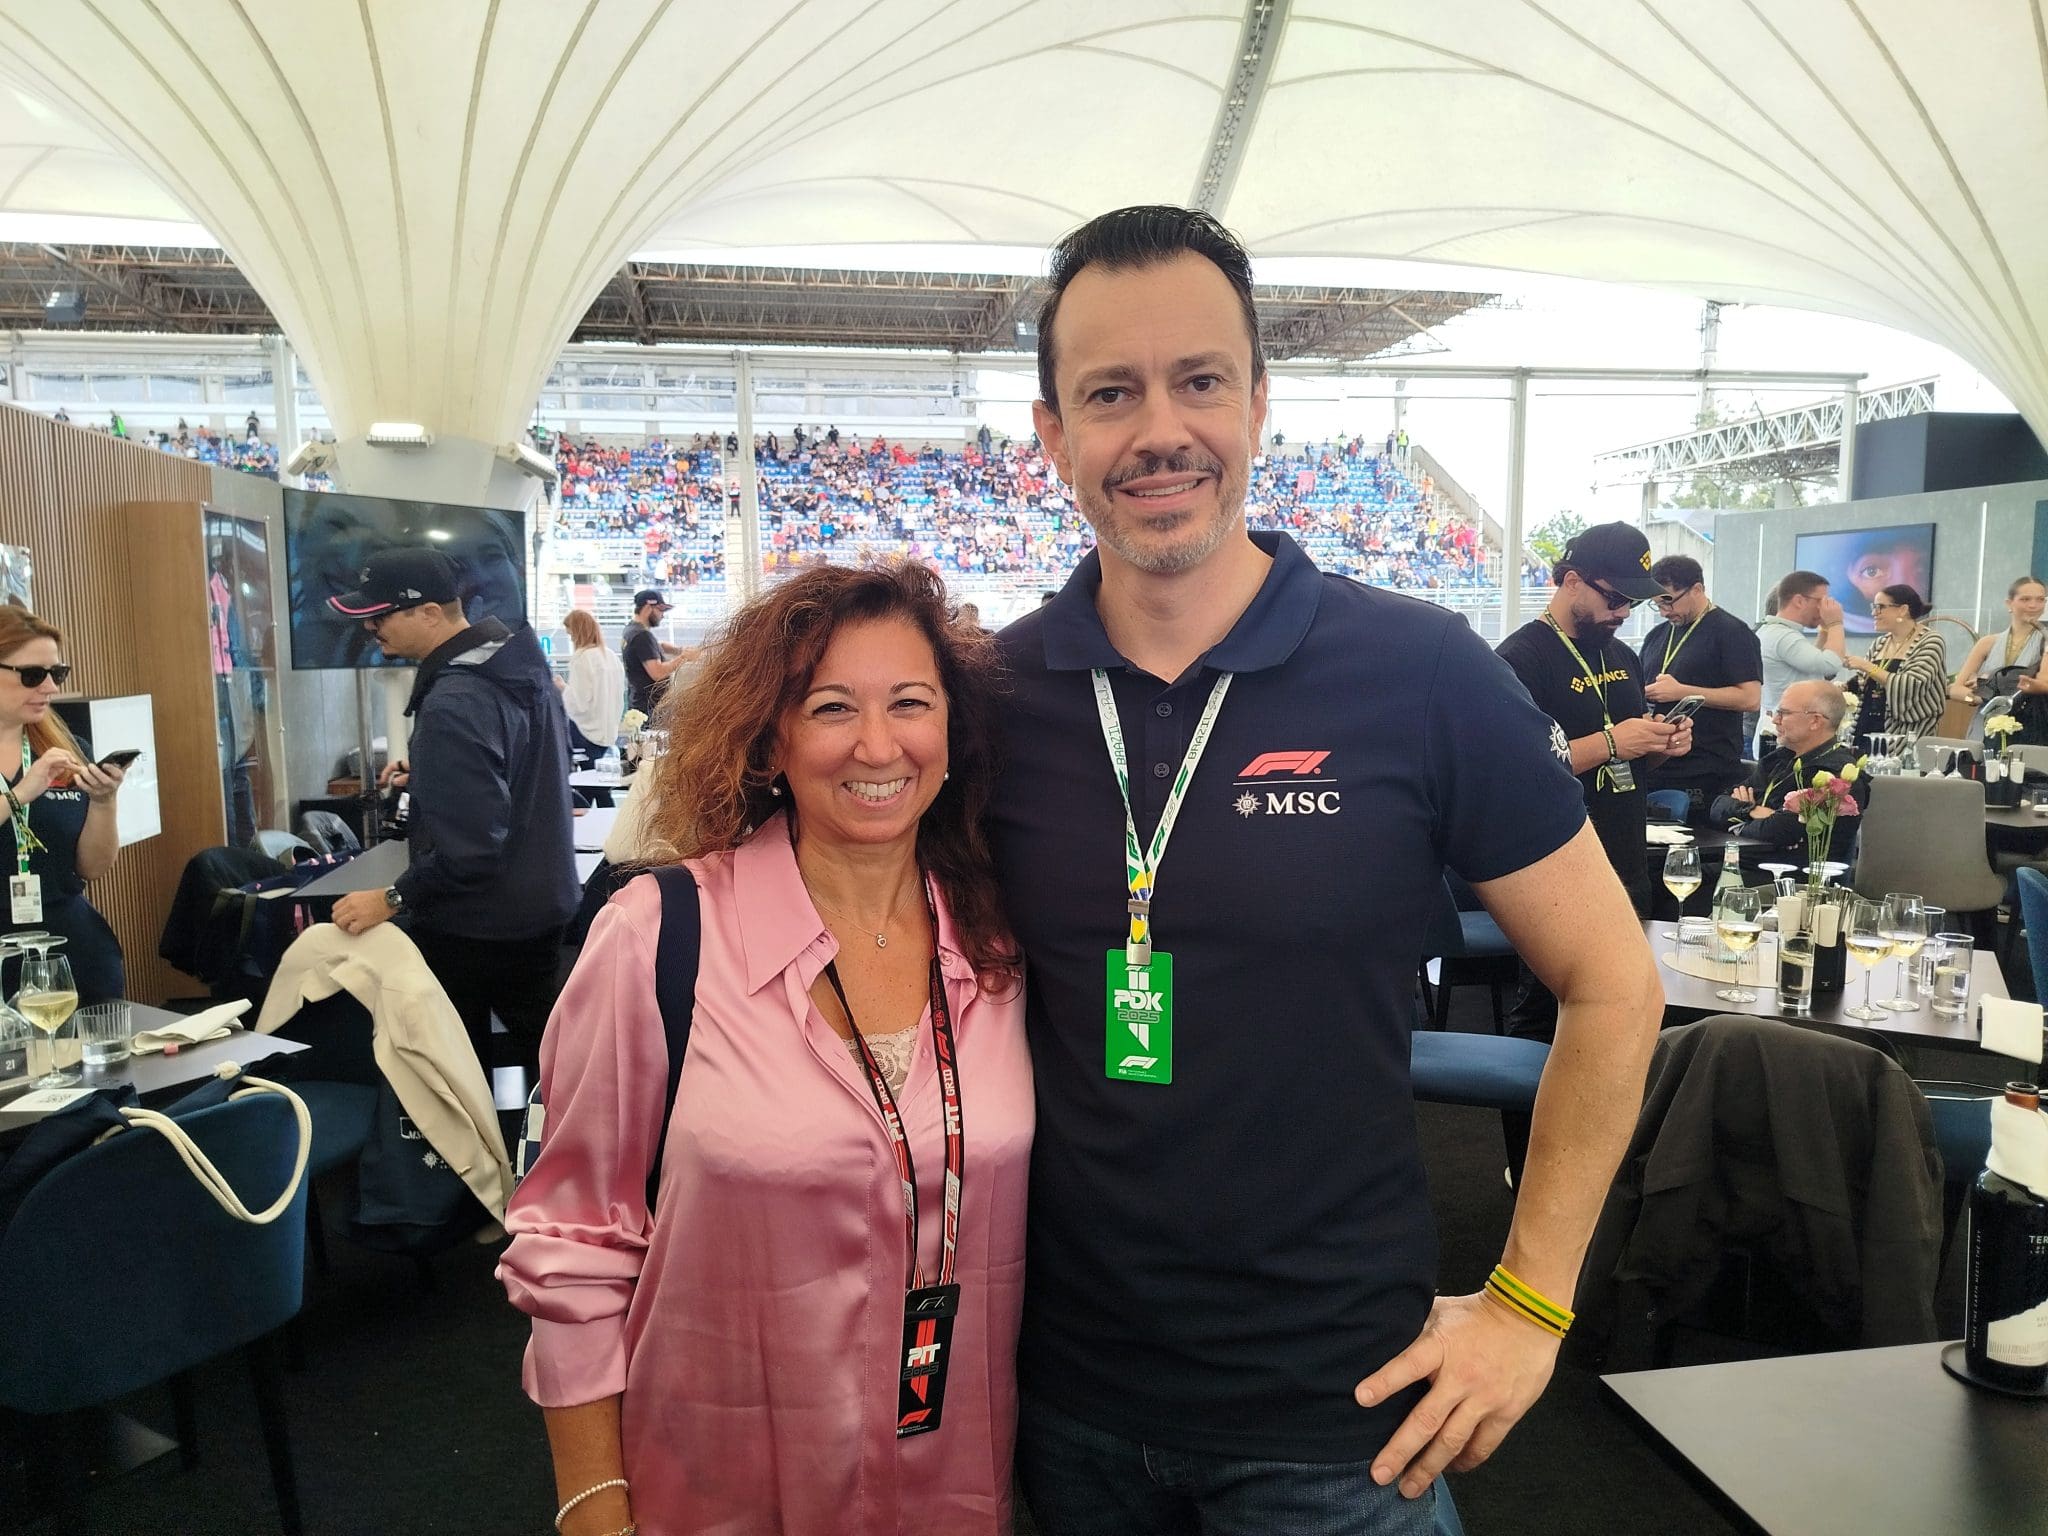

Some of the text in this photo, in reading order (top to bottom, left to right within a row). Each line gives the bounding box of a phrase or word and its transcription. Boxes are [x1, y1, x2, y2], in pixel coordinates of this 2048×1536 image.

[1583, 669, 1630, 688] BANCE
[1108, 722, 1128, 766] BRAZIL
[1187, 713, 1214, 760] BRAZIL
[55, 790, 82, 802] MSC
[1265, 791, 1341, 815] MSC
[1113, 988, 1164, 1012] PDK
[1118, 1008, 1161, 1024] 2025
[5, 1059, 16, 1071] 21
[943, 1068, 961, 1136] PIT GRID
[906, 1343, 941, 1368] PIT
